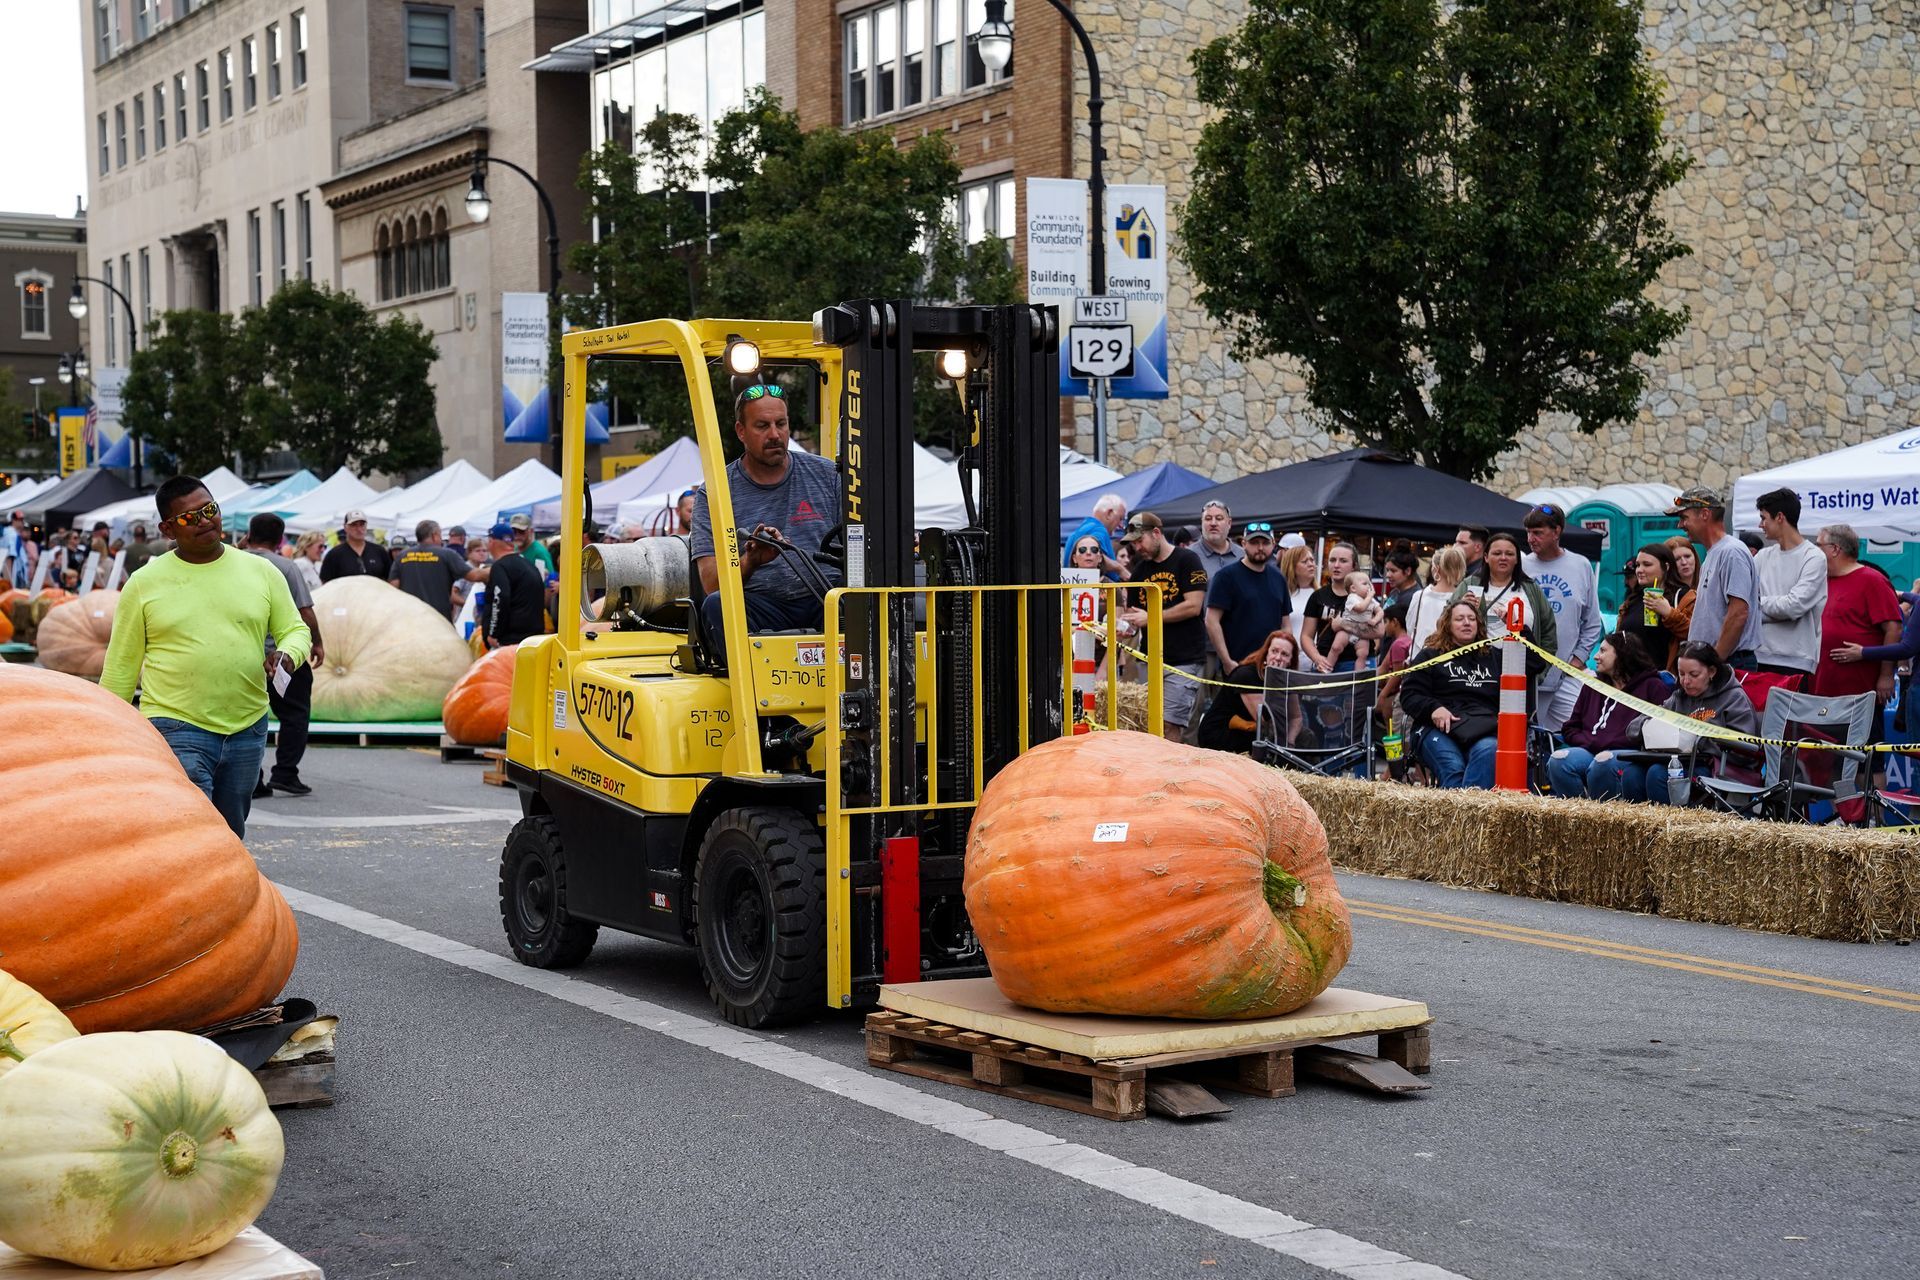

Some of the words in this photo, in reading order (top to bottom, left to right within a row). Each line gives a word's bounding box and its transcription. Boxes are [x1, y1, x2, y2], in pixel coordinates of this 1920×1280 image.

[1030, 220, 1084, 237] Community
[1031, 233, 1082, 246] Foundation
[1031, 270, 1076, 285] Building
[1109, 276, 1150, 290] Growing
[1030, 285, 1084, 297] Community
[1082, 301, 1119, 317] WEST
[1077, 339, 1122, 363] 129
[505, 356, 541, 367] Building
[848, 369, 861, 522] HYSTER
[1808, 489, 1874, 511] Tasting
[726, 527, 740, 568] 57-70-12
[1534, 574, 1573, 598] AMPION
[580, 682, 635, 741] 57-70-12
[690, 710, 730, 724] 57-70
[705, 729, 722, 747] 12
[571, 764, 602, 787] HYSTER
[603, 777, 626, 796] 50XT
